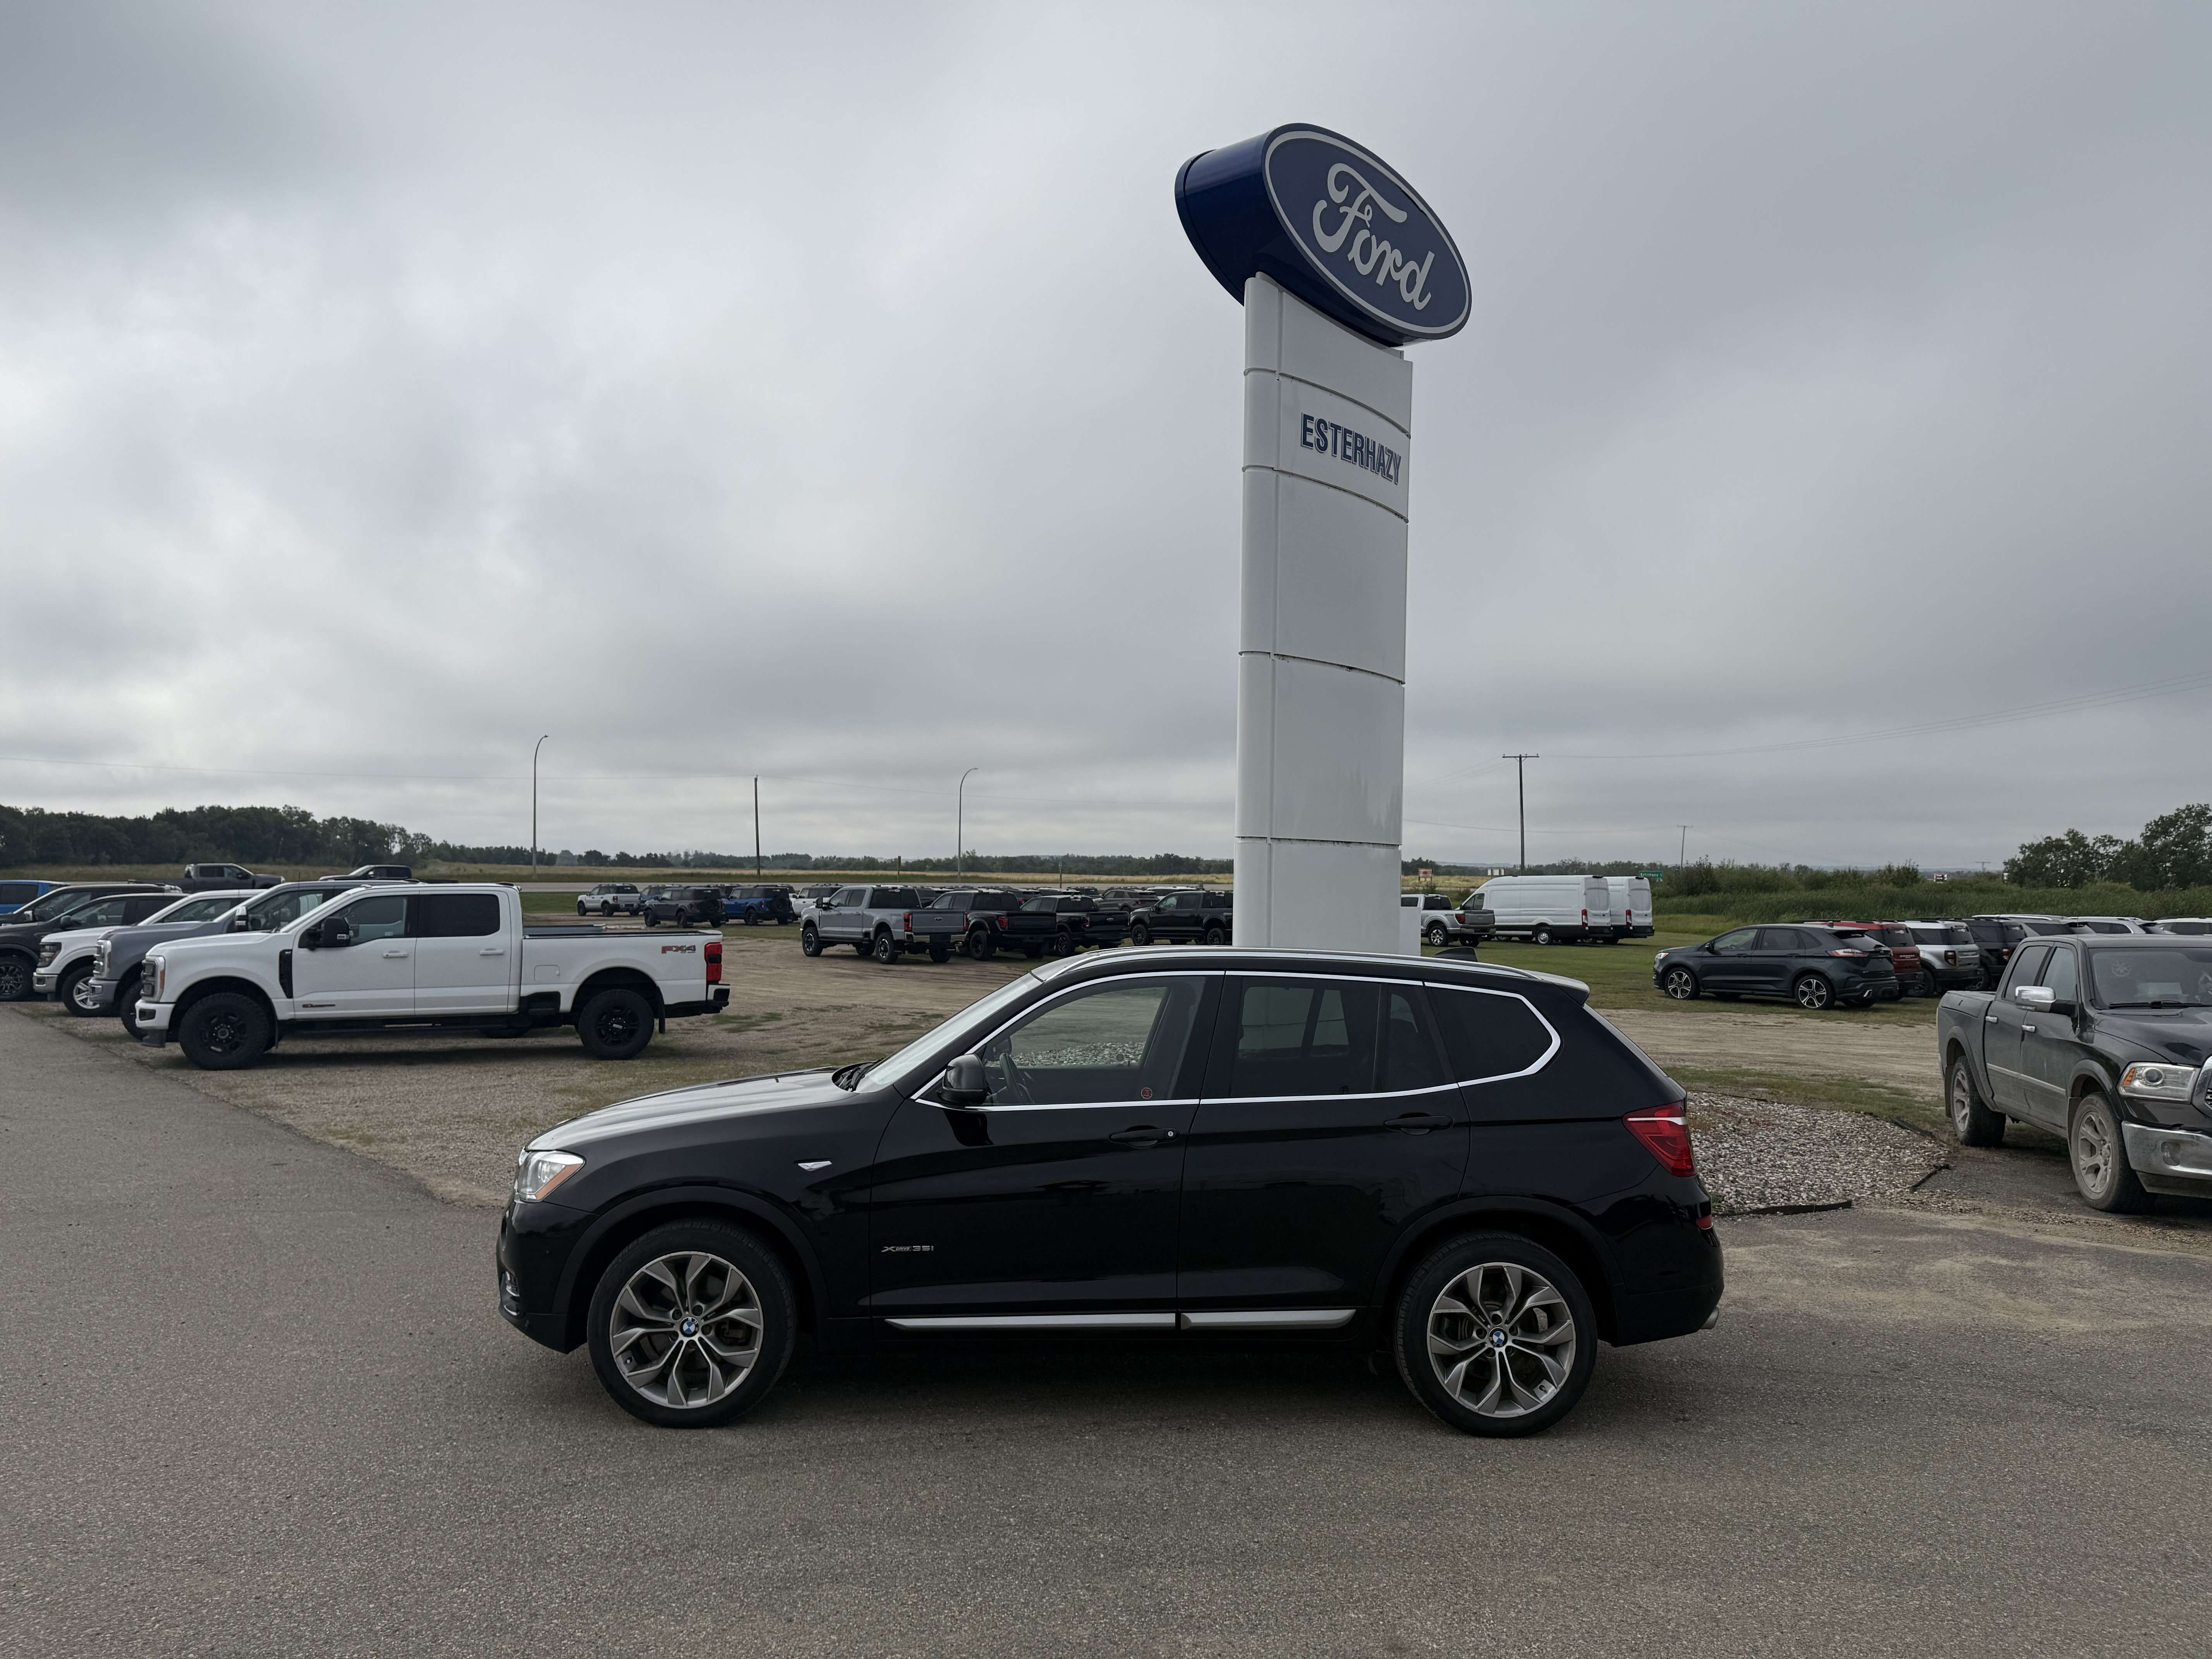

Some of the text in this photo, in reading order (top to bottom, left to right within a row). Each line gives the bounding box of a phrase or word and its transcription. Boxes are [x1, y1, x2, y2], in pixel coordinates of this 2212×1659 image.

[1313, 163, 1435, 310] Ford
[1301, 412, 1401, 485] ESTERHAZY
[661, 945, 696, 953] FX4
